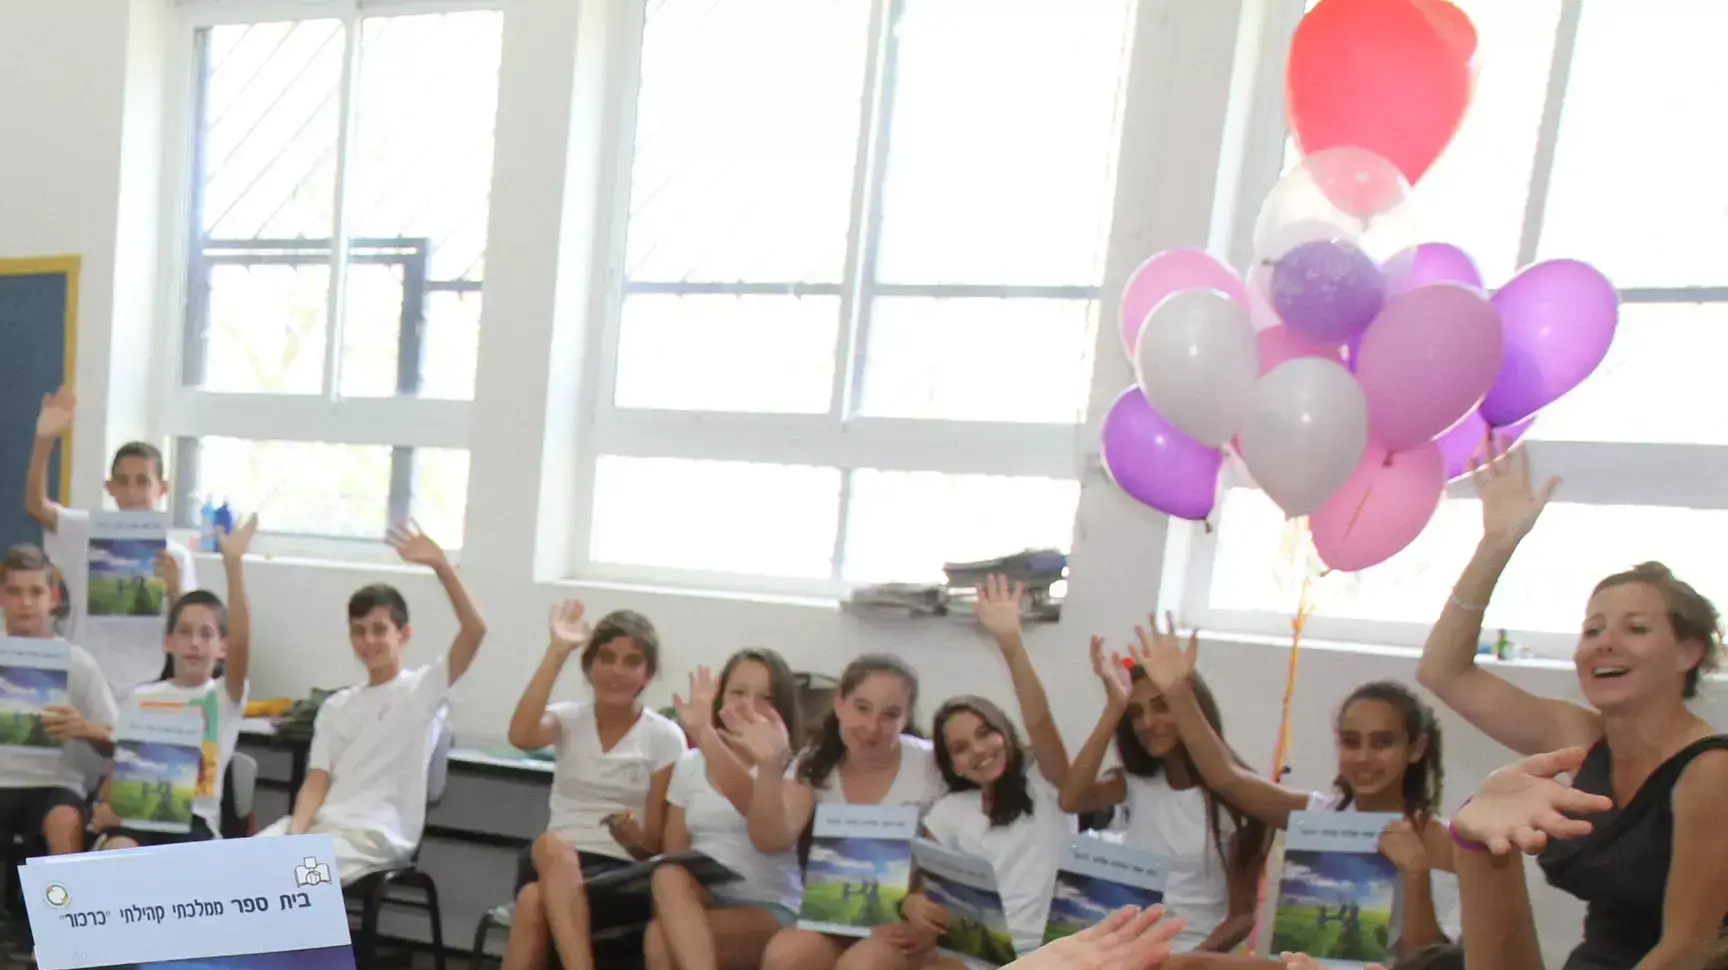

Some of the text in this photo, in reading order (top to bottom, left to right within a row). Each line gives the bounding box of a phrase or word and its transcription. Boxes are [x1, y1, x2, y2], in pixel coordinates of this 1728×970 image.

[172, 900, 224, 920] ממלכתי
[230, 896, 269, 914] ספר
[280, 891, 312, 911] בית
[120, 904, 166, 925] קהילתי
